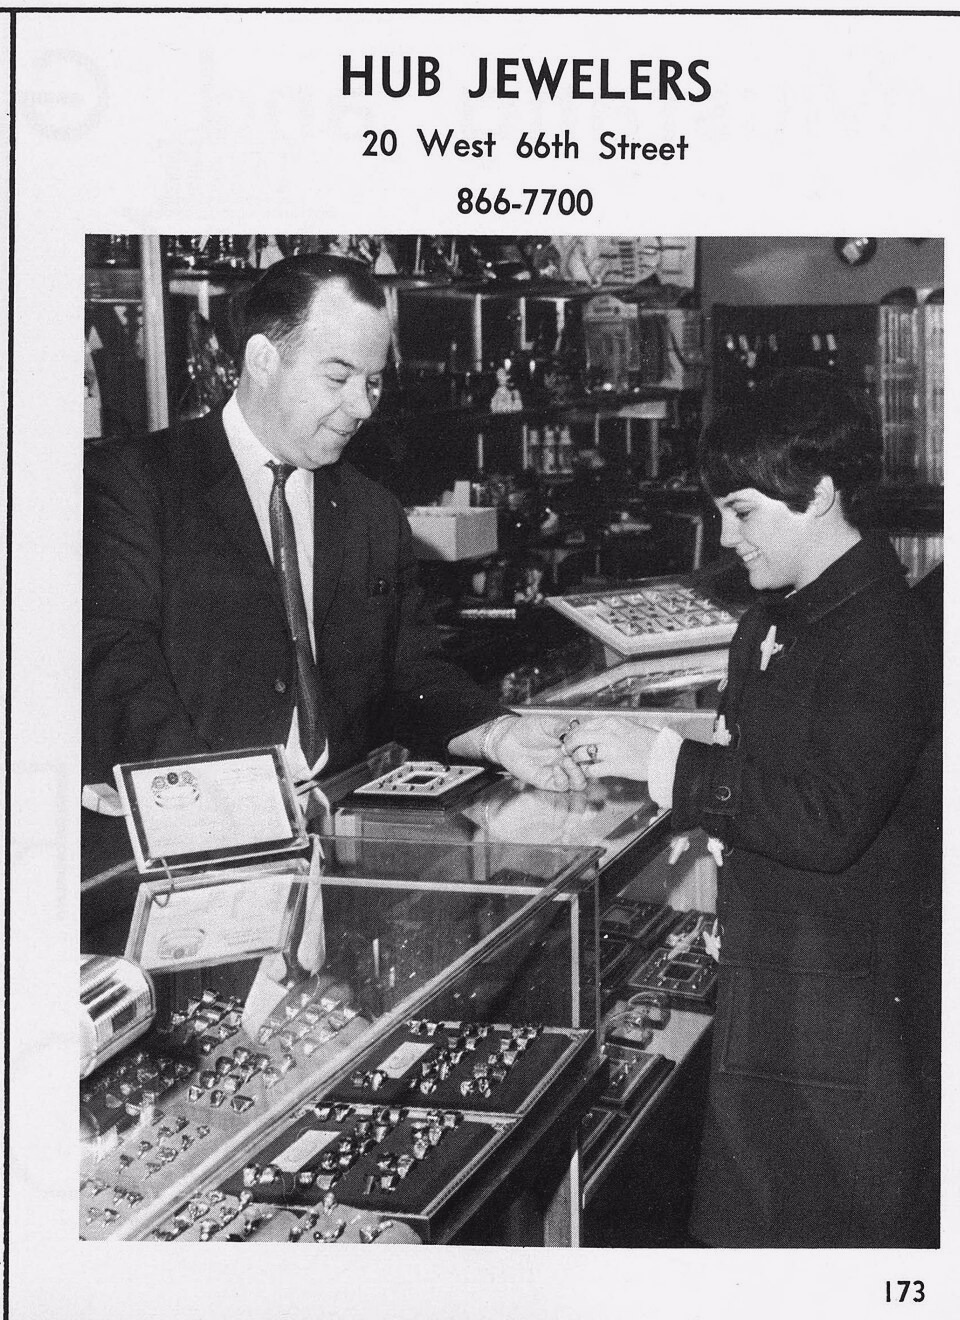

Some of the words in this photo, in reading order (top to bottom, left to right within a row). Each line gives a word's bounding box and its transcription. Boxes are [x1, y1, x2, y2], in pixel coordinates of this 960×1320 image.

[343, 55, 440, 98] HUB
[469, 57, 711, 102] JEWELERS
[363, 130, 397, 156] 20
[417, 129, 496, 157] West
[517, 130, 578, 158] 66th
[599, 131, 688, 160] Street
[457, 188, 593, 216] 866-7700
[886, 1280, 926, 1303] 173
